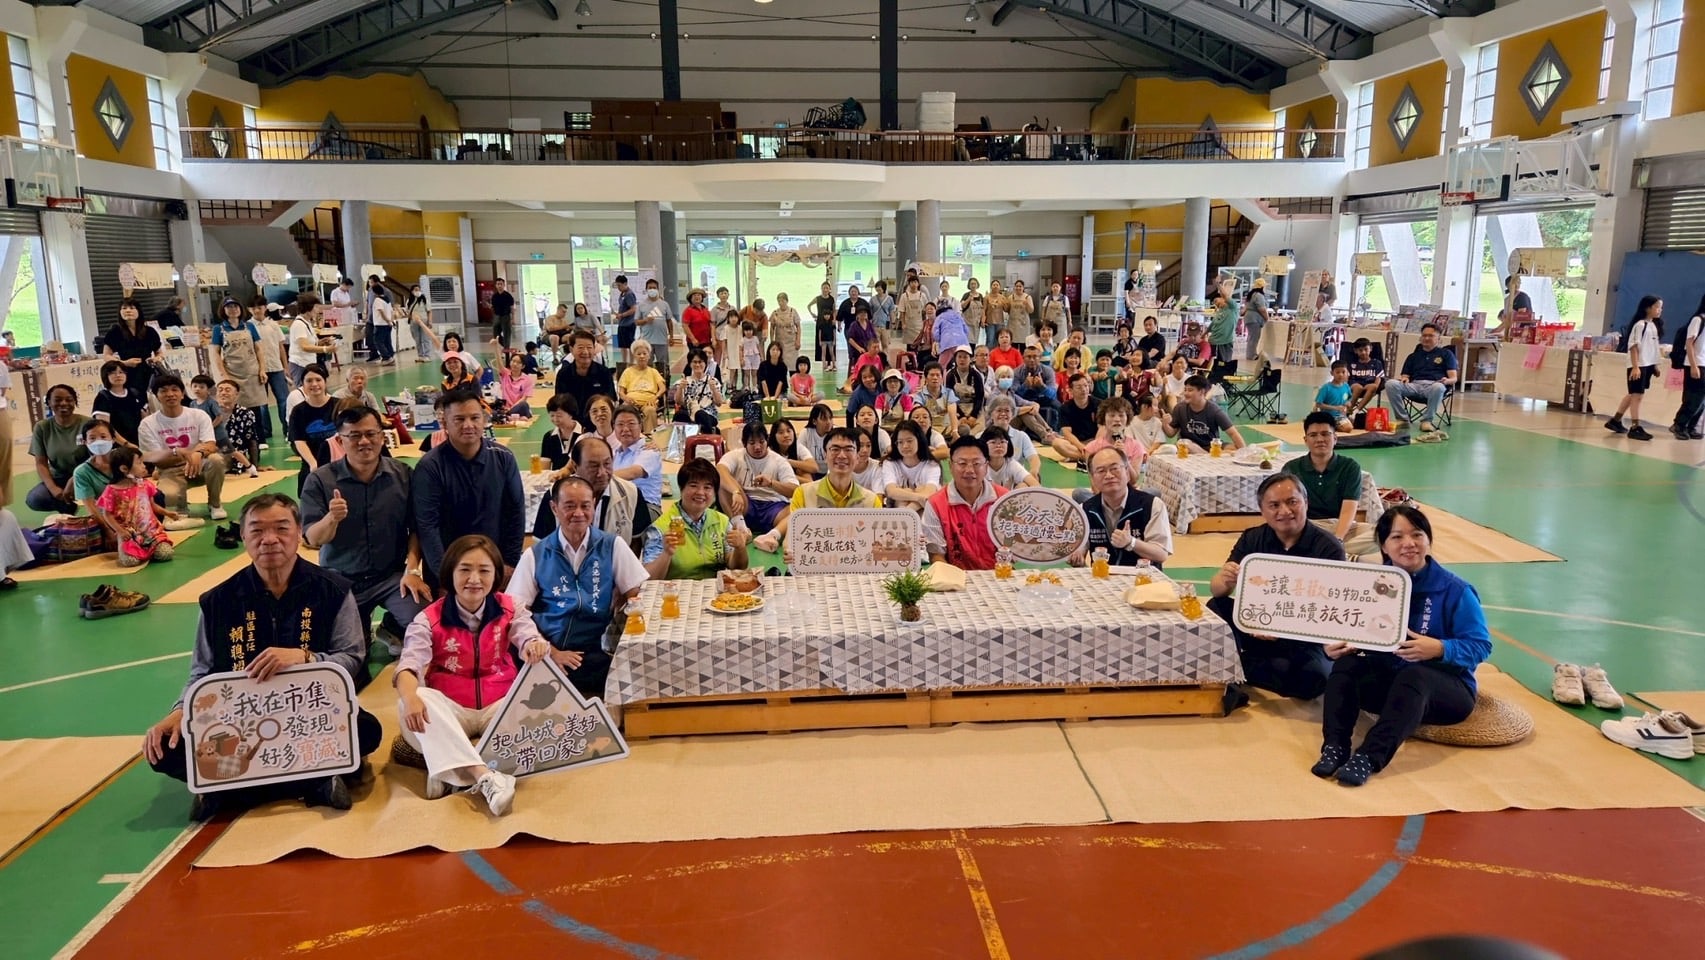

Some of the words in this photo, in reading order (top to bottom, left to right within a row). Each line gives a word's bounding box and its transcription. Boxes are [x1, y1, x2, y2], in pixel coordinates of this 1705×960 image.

[1018, 505, 1053, 525] 今天
[999, 520, 1076, 542] 把生活過慢一點
[803, 540, 857, 553] 不是亂花錢
[1269, 574, 1372, 603] 讓喜歡的物品
[1272, 600, 1363, 627] 繼續旅行
[233, 681, 332, 718] 我在市集
[283, 714, 334, 738] 發現
[259, 737, 340, 769] 好多寶藏
[515, 738, 582, 770] 帶回家
